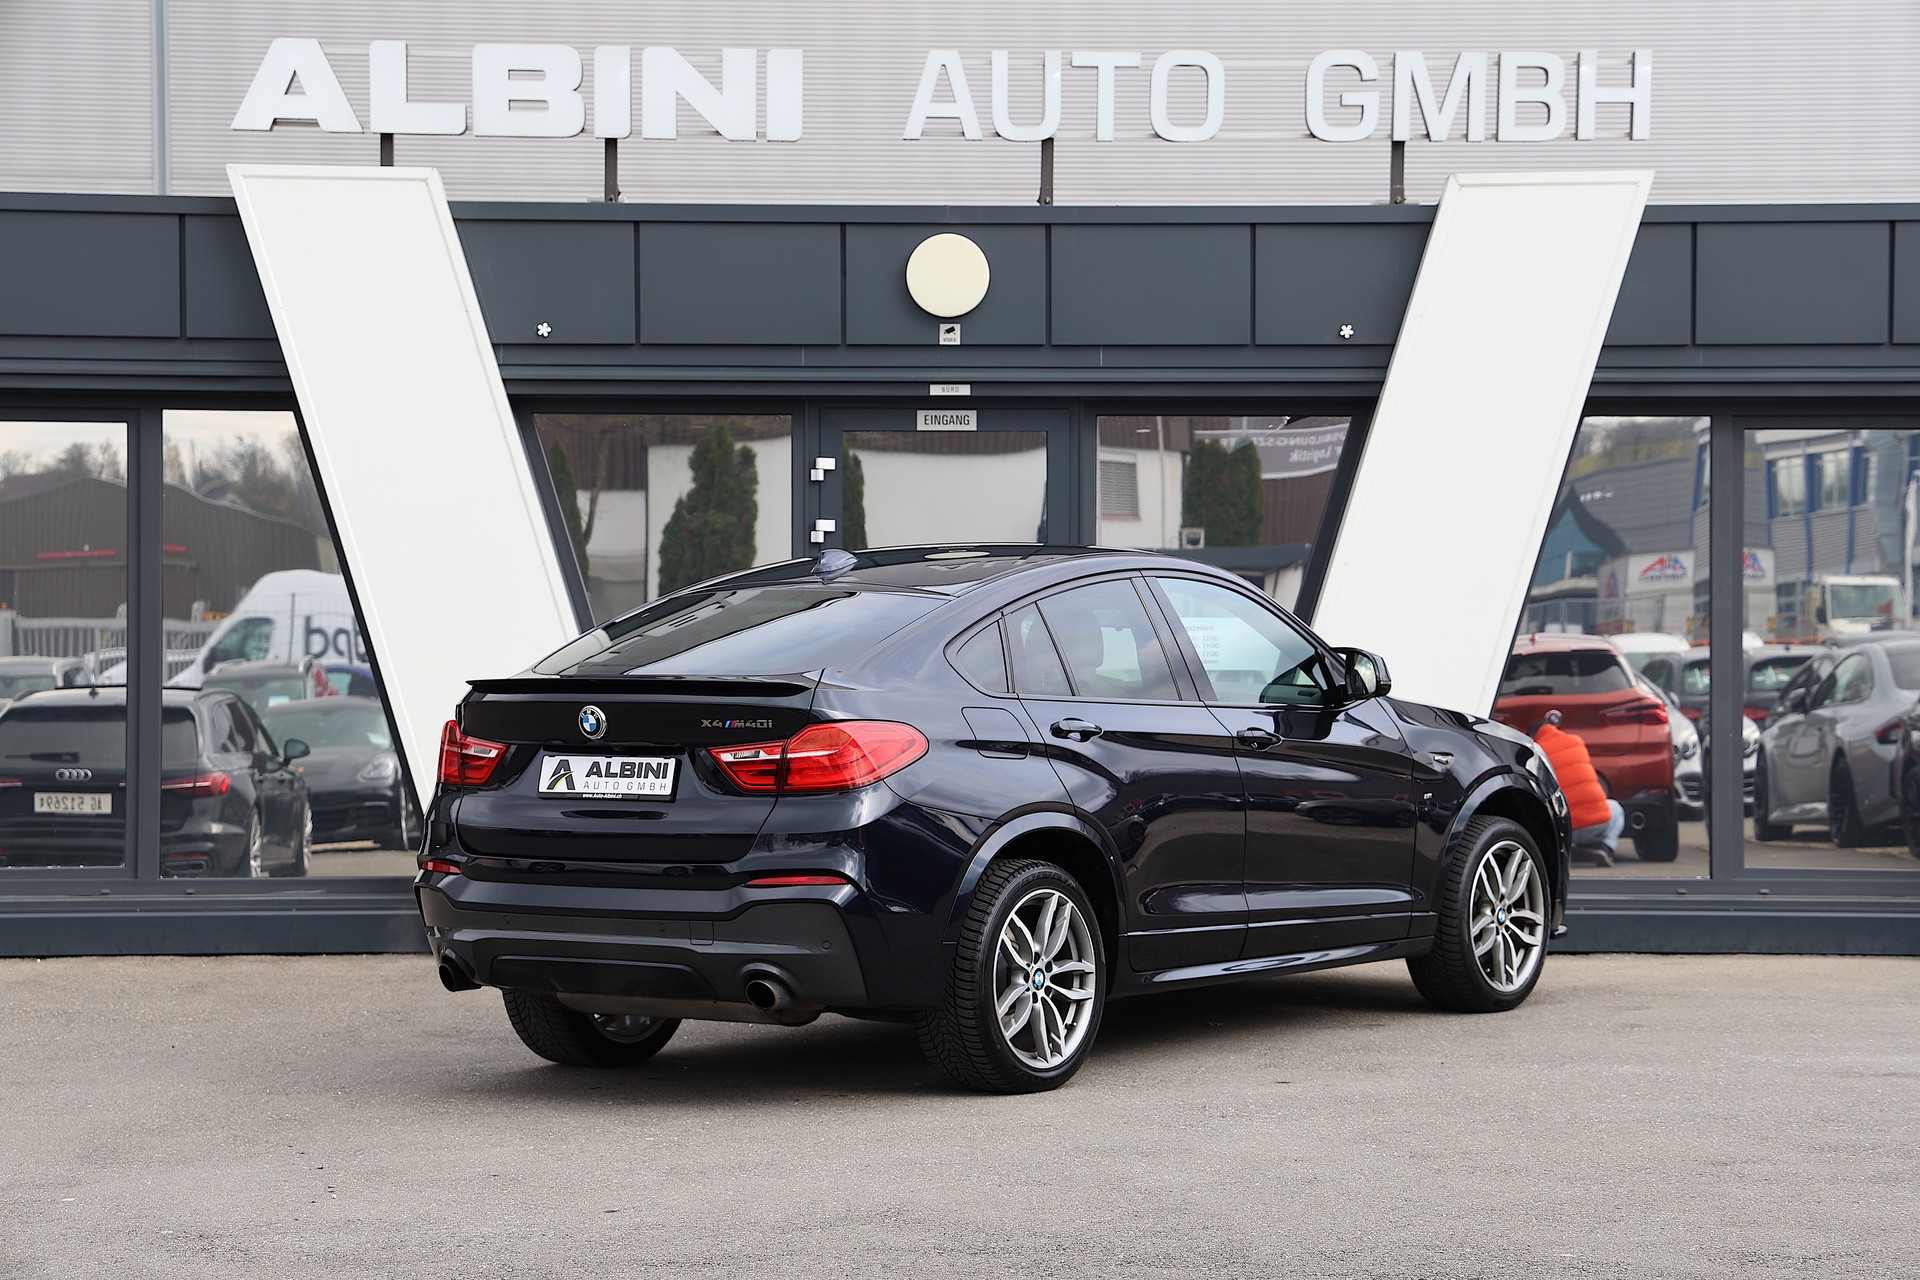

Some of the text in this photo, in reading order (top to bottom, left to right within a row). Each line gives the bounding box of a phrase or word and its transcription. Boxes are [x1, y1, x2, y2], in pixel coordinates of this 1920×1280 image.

[230, 37, 1653, 144] ALBINI AUTO GMBH
[941, 385, 960, 393] BÜRO
[924, 414, 970, 426] EINGANG
[700, 719, 773, 728] X4 M40i
[584, 761, 670, 780] ALBINI
[583, 780, 667, 792] AUTO GMBH
